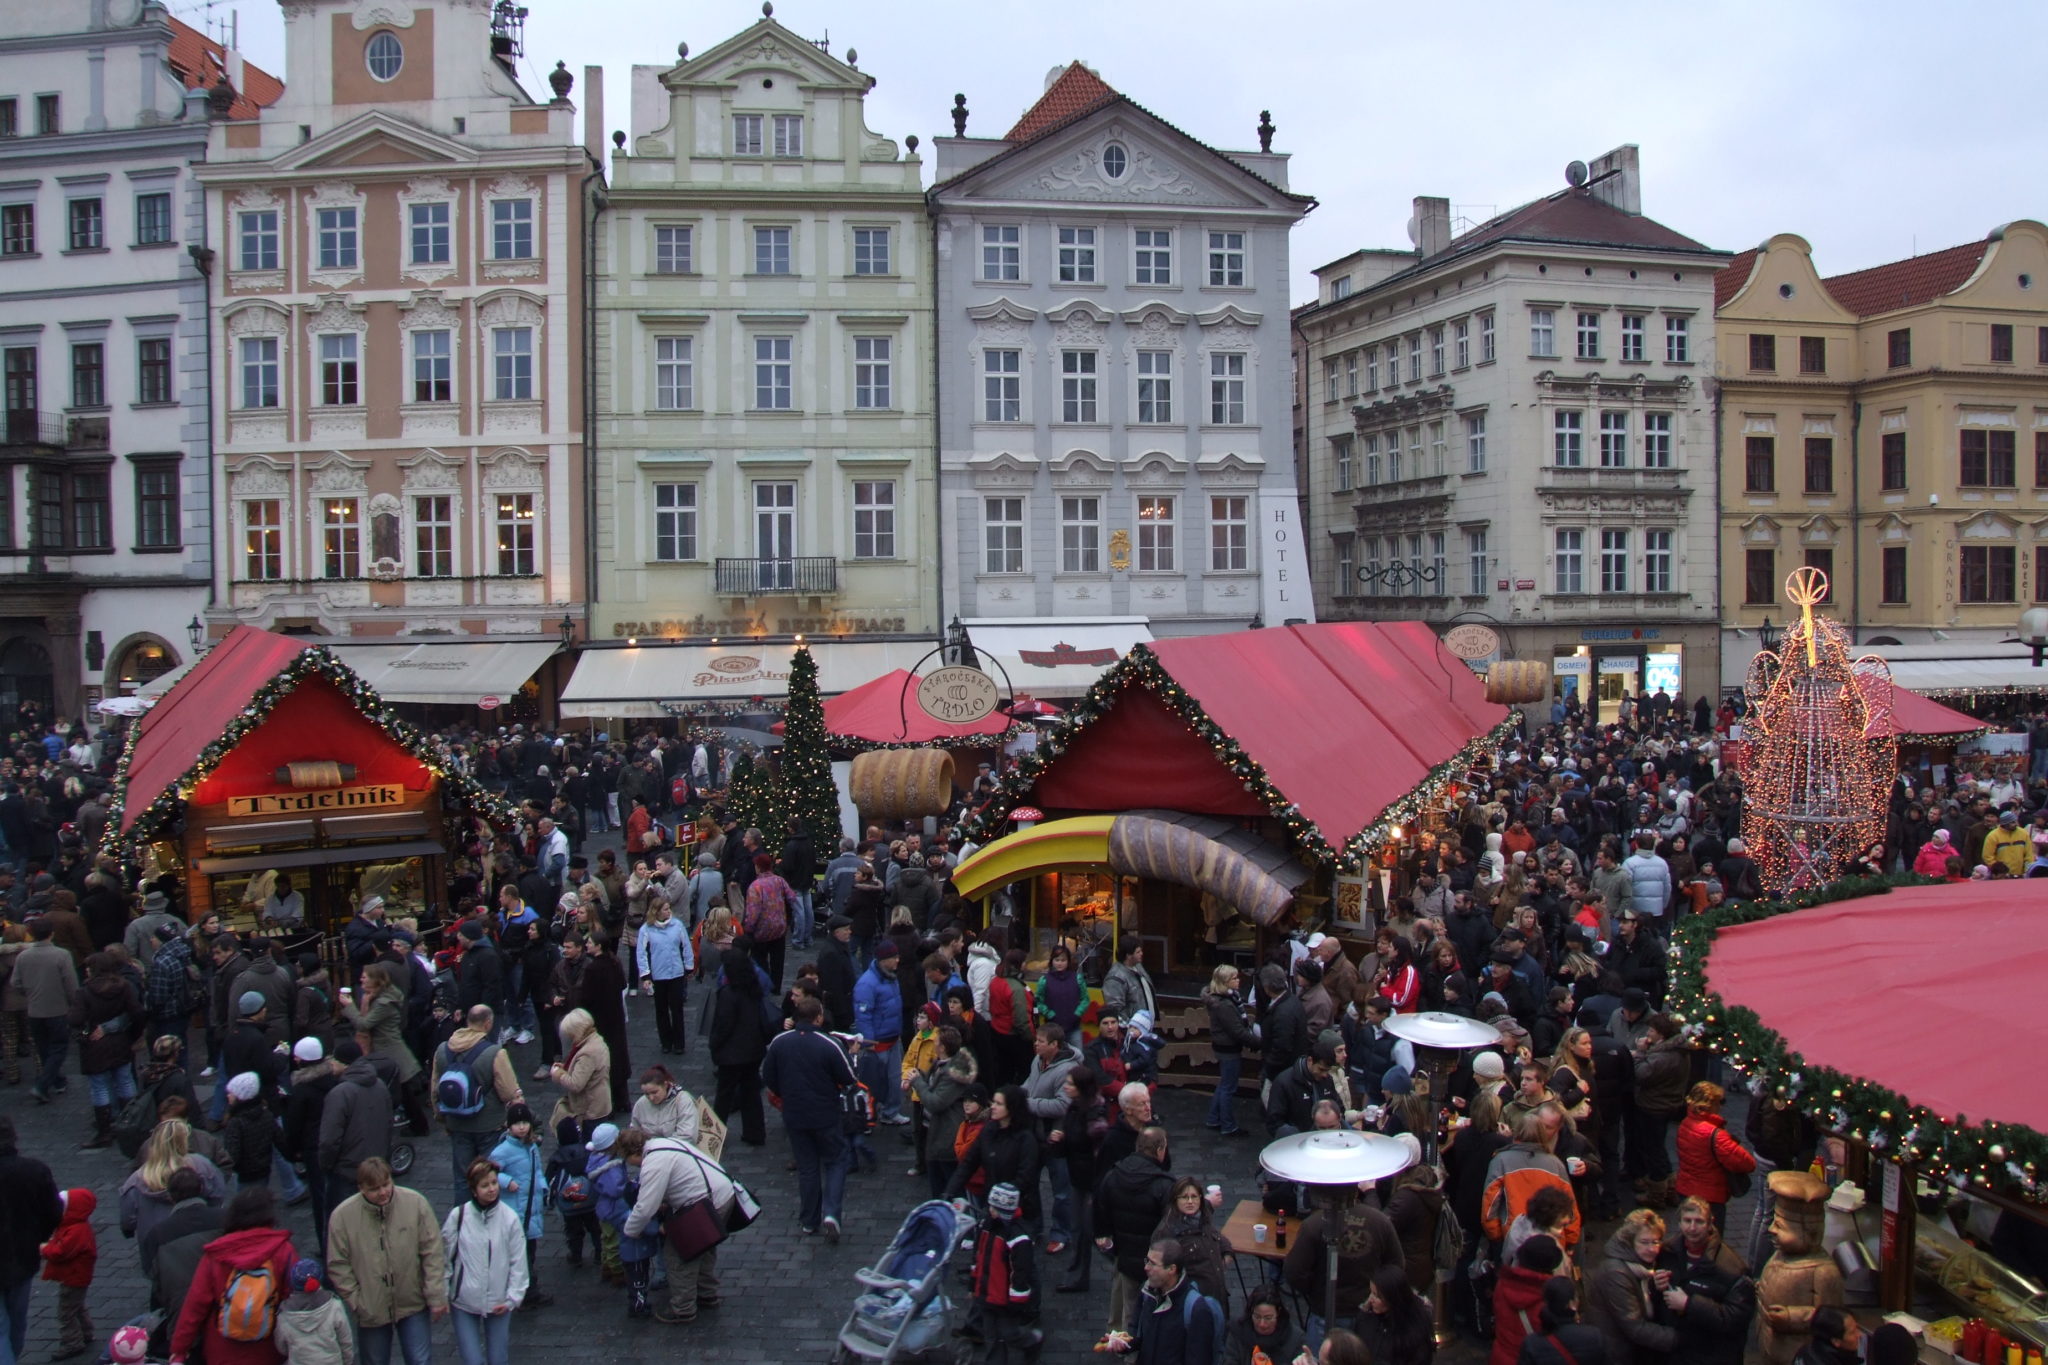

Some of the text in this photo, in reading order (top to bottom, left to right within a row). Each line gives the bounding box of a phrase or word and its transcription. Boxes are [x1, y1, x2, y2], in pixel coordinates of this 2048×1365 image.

[1275, 510, 1289, 602] HOTEL
[1945, 539, 1953, 602] GRAND
[613, 611, 906, 637] STAROMĚSTSKÁ RESTAURACE
[1454, 641, 1490, 656] TRDLO
[1556, 661, 1587, 670] ОБМЕН
[1602, 660, 1635, 669] CHANGE
[693, 672, 758, 687] Pilsner
[1647, 667, 1679, 687] 0%
[932, 694, 986, 718] TRDLO
[234, 786, 397, 814] Trdelník
